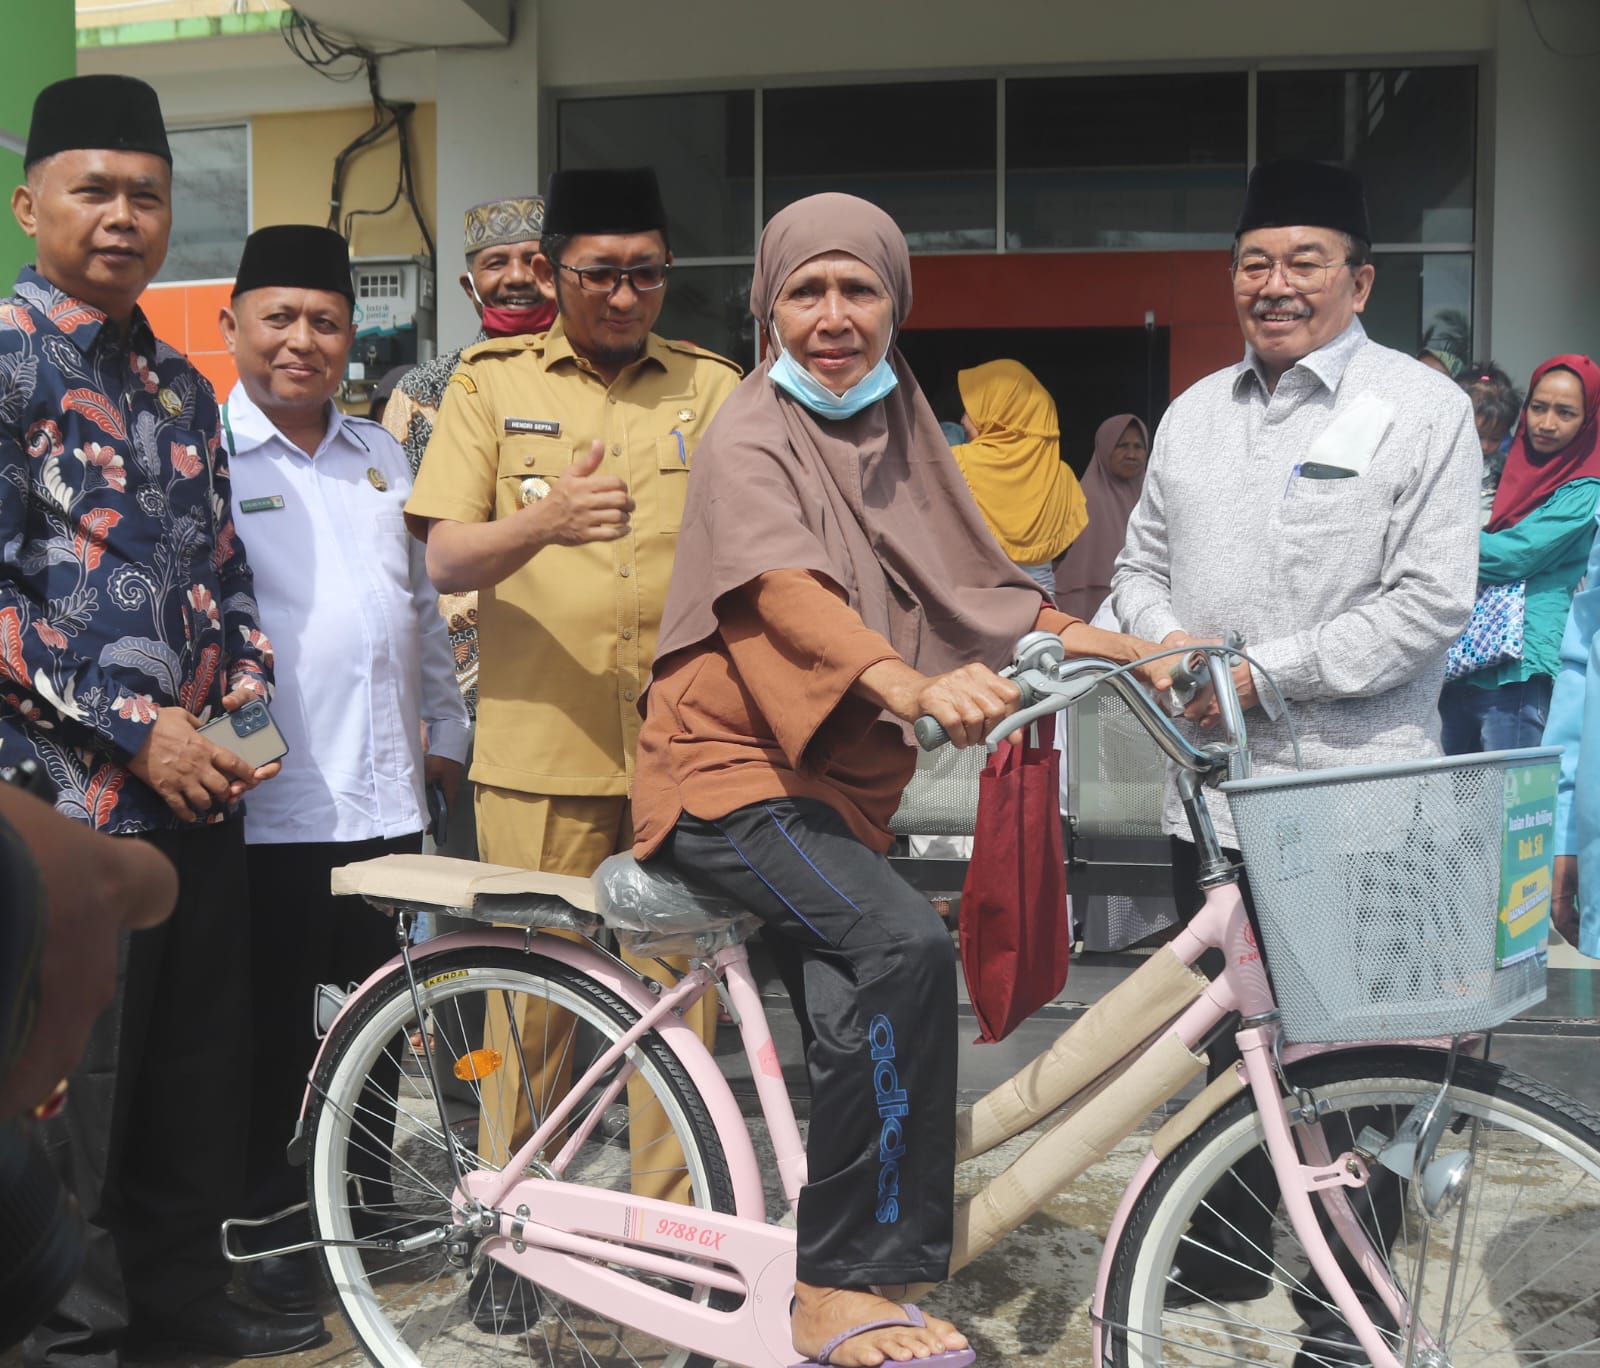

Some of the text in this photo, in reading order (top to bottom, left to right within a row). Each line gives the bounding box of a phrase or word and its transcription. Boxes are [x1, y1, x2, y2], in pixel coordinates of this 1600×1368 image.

[511, 421, 552, 431] HENDRI SEPTA
[428, 970, 465, 986] KENDA
[868, 1013, 909, 1224] adidas
[655, 1218, 697, 1242] 9788
[698, 1228, 727, 1251] GX
